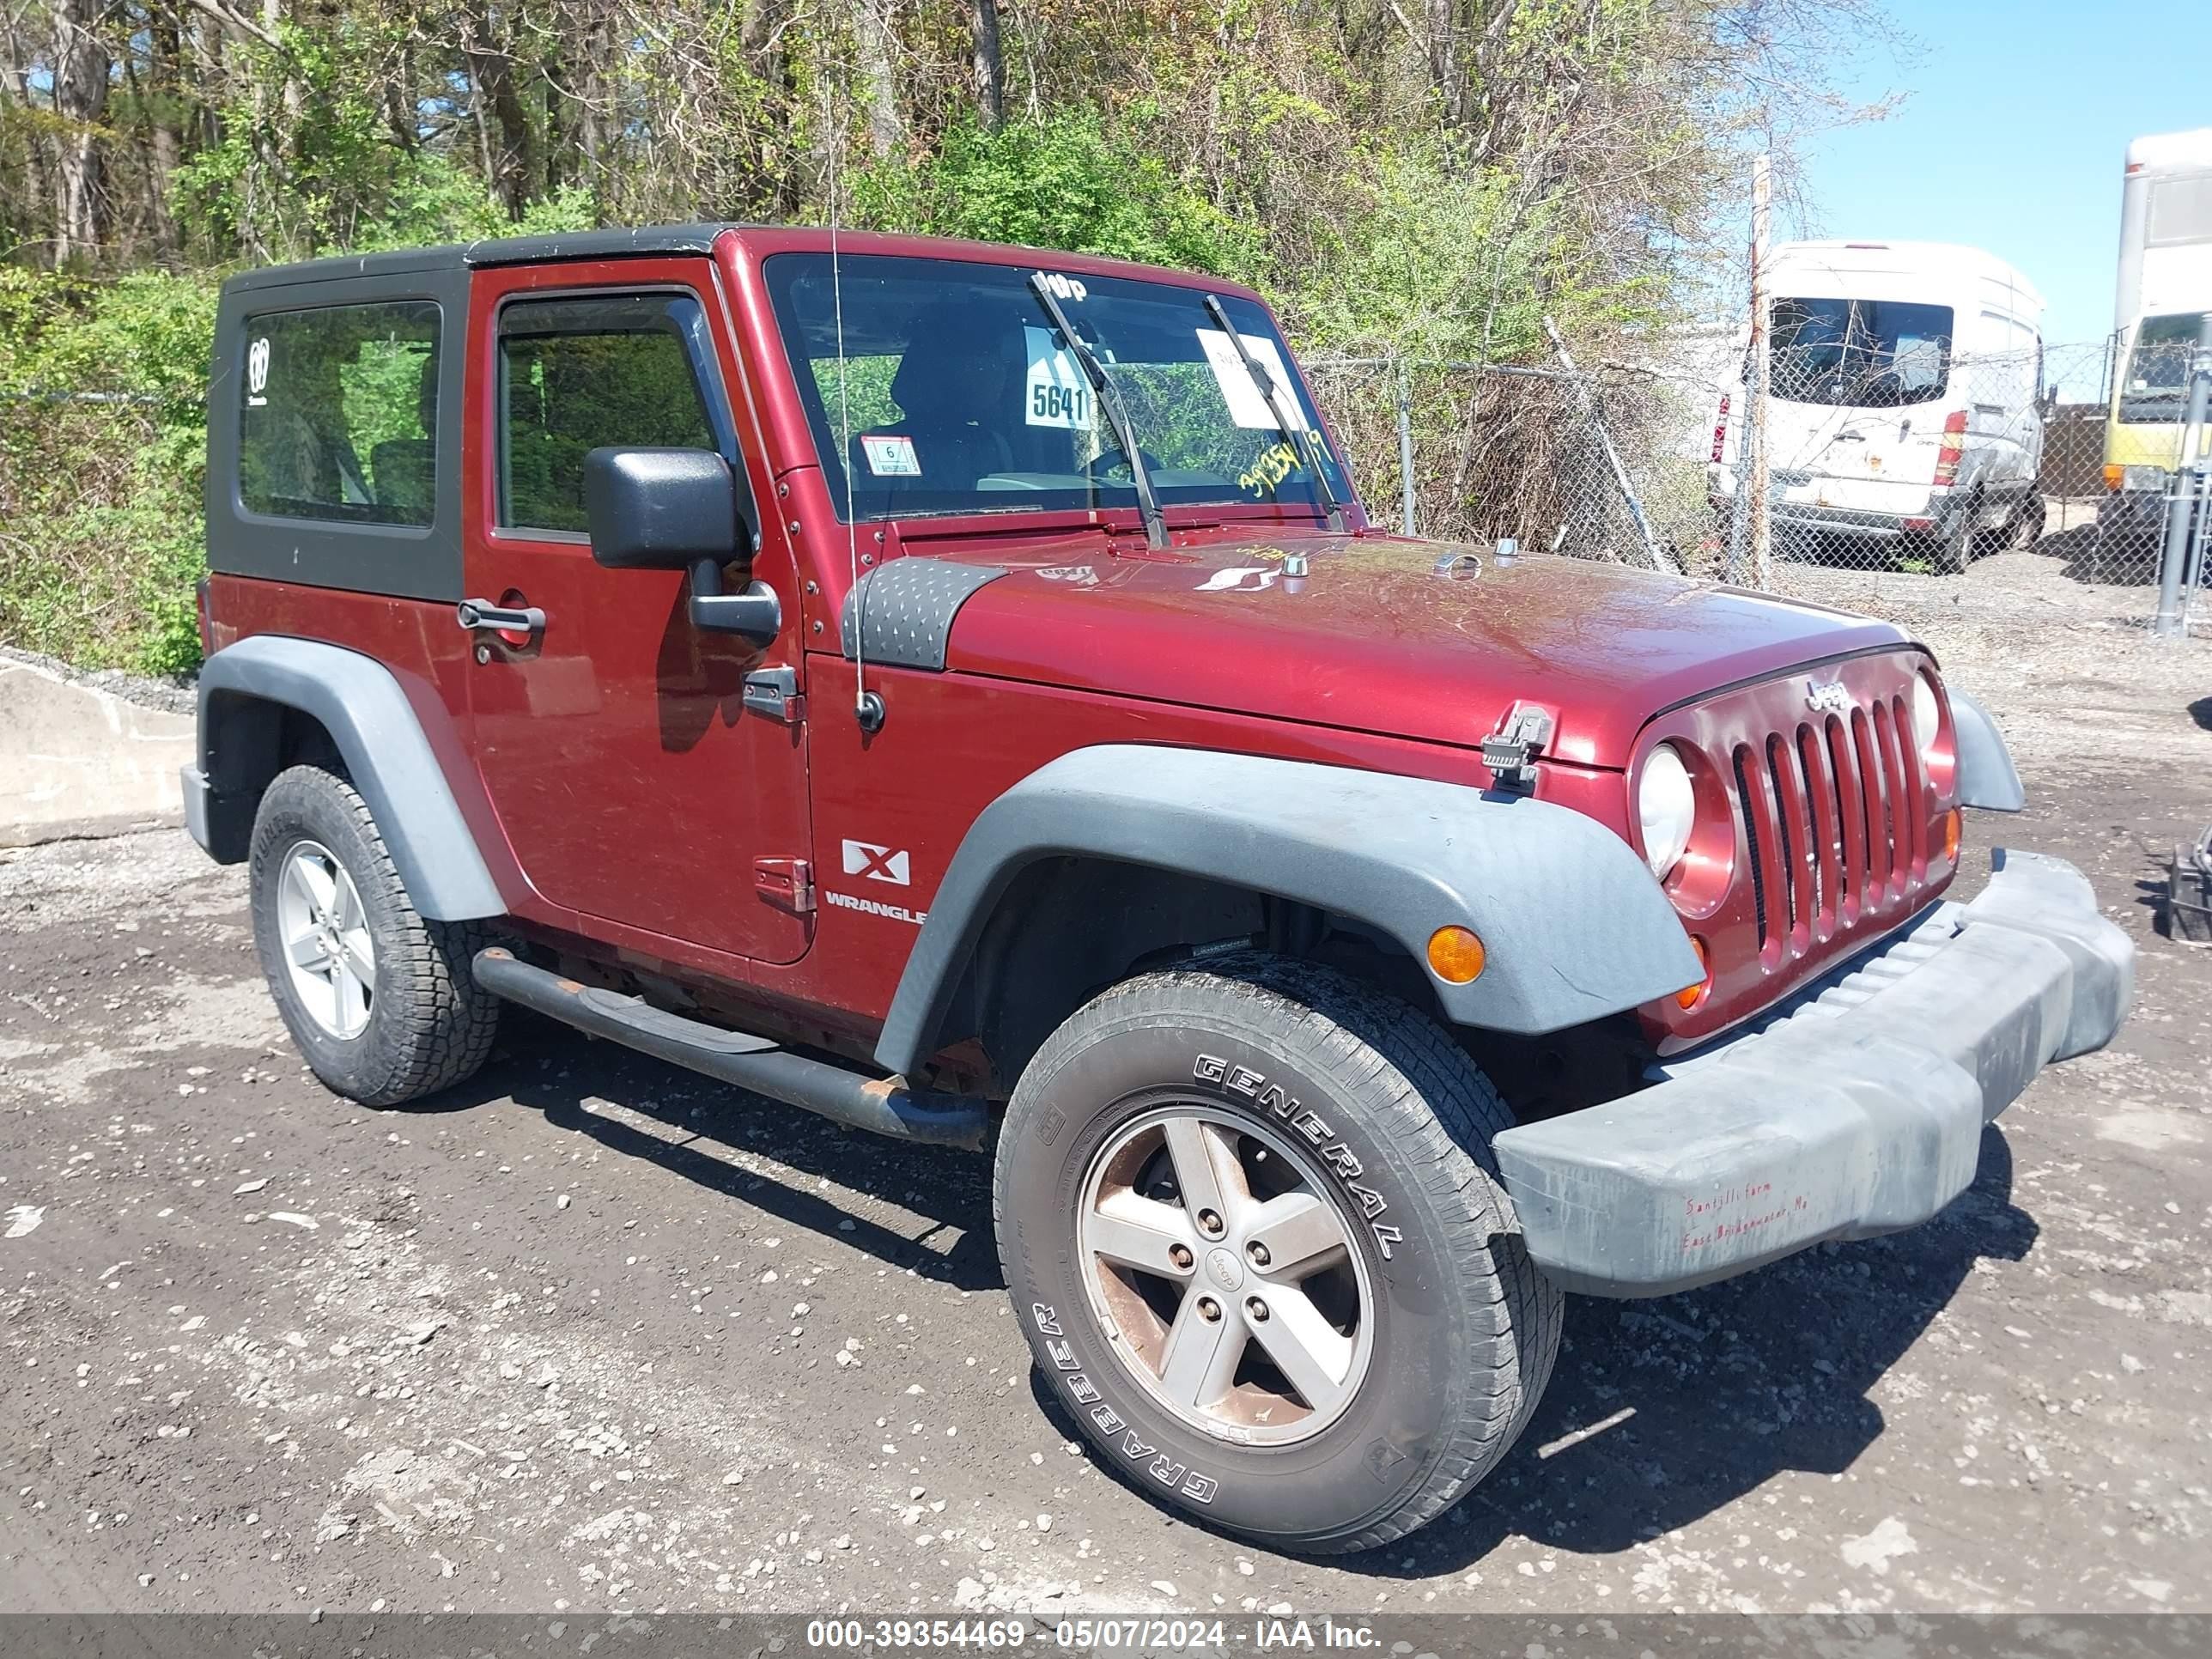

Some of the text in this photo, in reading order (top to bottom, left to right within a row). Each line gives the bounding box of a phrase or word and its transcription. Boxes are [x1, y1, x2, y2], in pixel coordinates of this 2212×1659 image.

[1033, 384, 1084, 421] 5641
[886, 447, 895, 459] 6
[1804, 681, 1849, 712] Jeep
[824, 890, 928, 925] WRANGLE
[1193, 1053, 1404, 1261] GENERAL
[1211, 1254, 1235, 1286] Jeep
[1032, 1302, 1218, 1504] GRABBER
